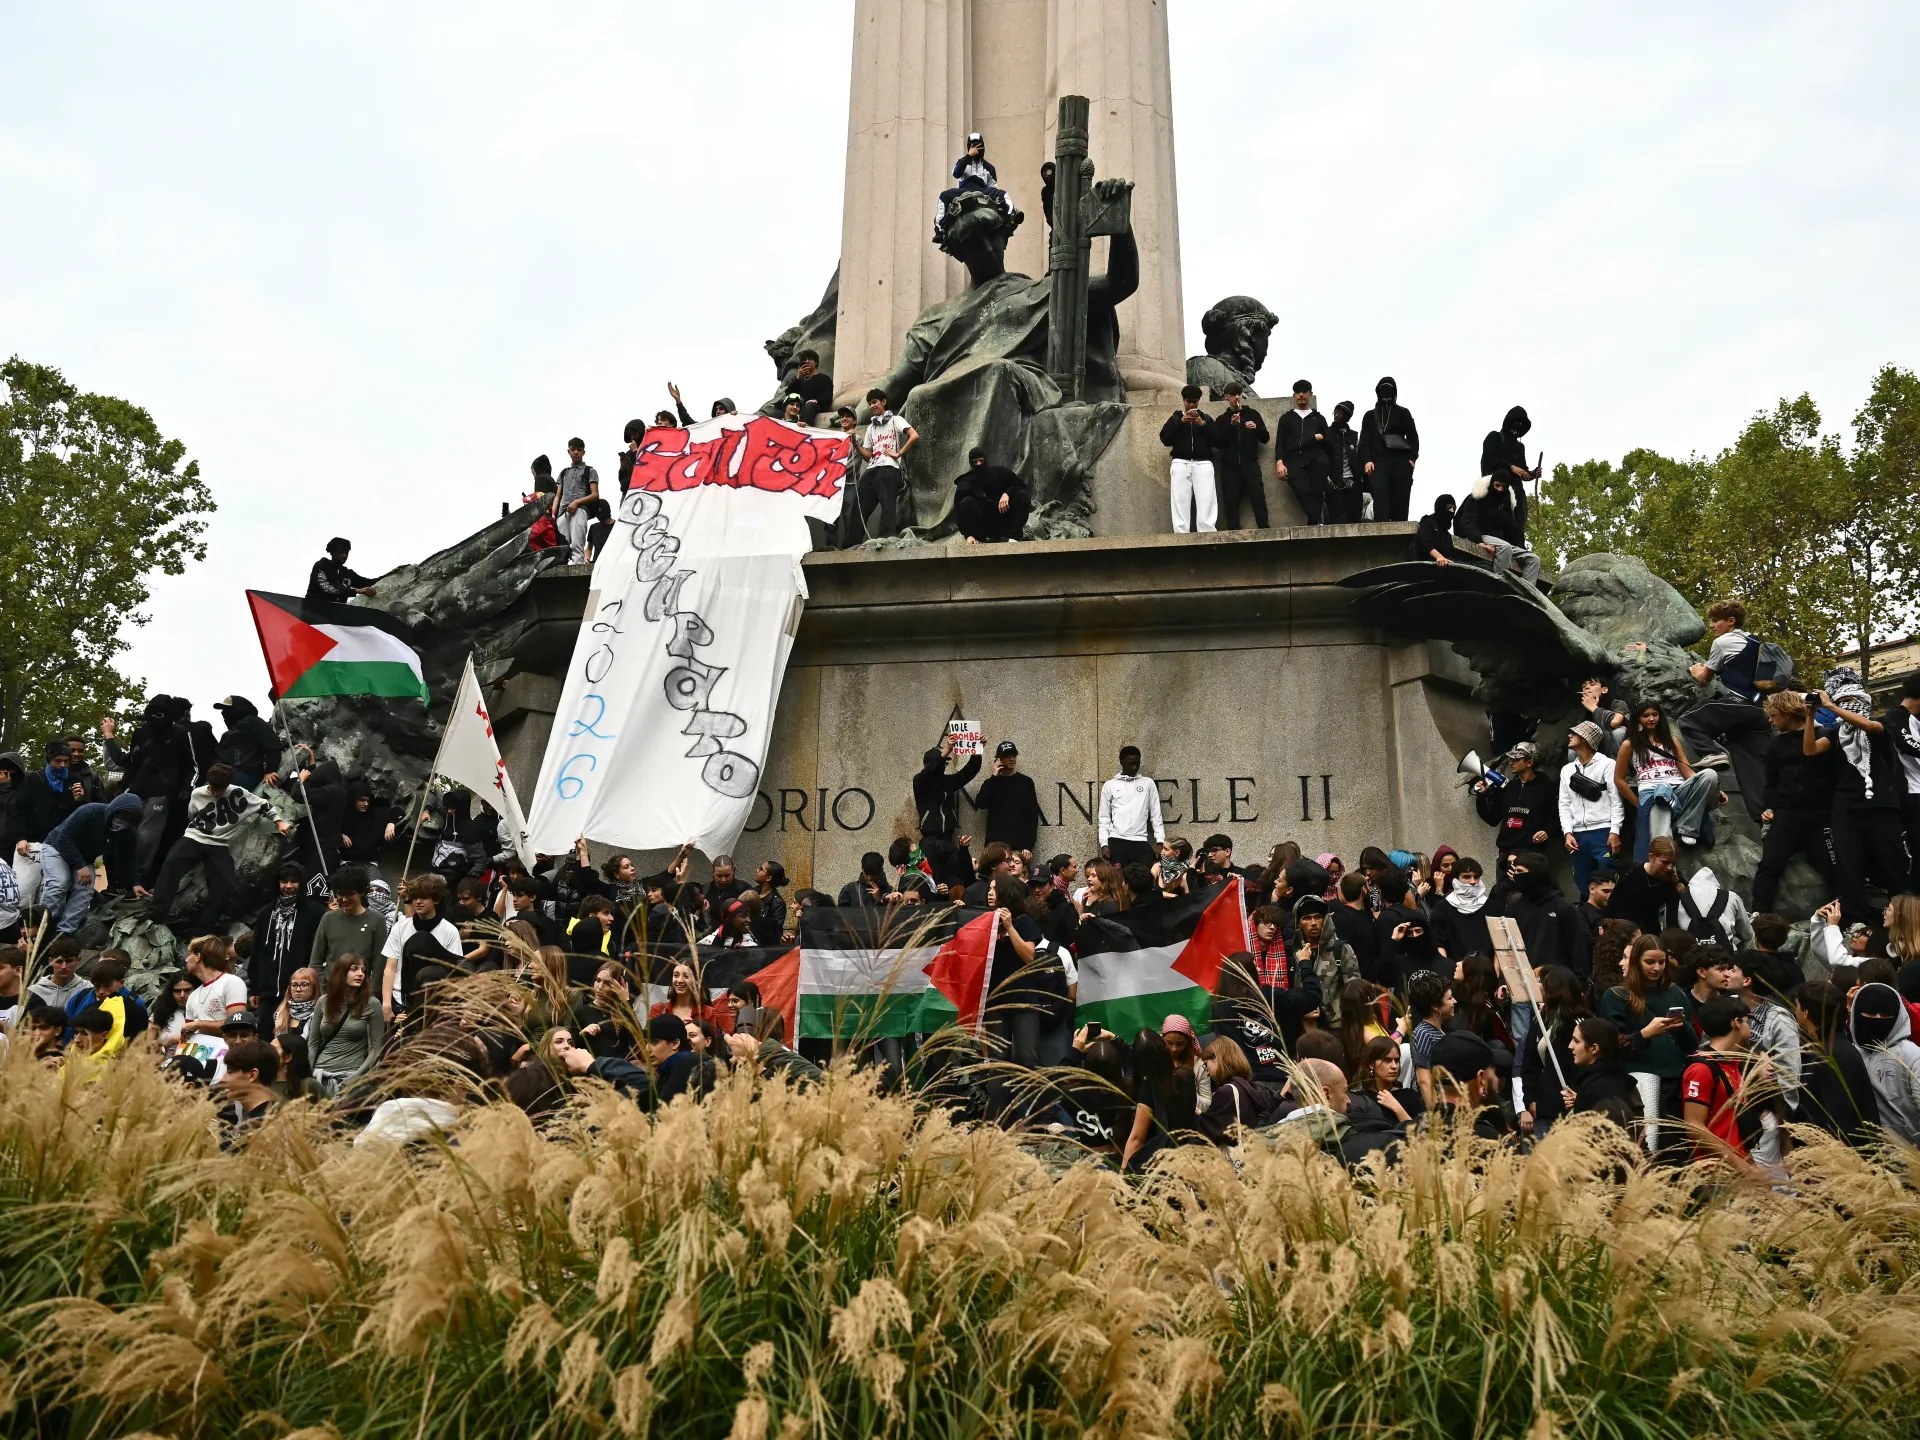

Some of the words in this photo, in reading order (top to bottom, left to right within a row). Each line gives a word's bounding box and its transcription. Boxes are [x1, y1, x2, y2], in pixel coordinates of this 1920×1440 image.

[953, 732, 980, 741] BOMBE
[743, 787, 876, 832] ORIO
[1297, 774, 1335, 822] II
[1688, 1080, 1700, 1098] 5
